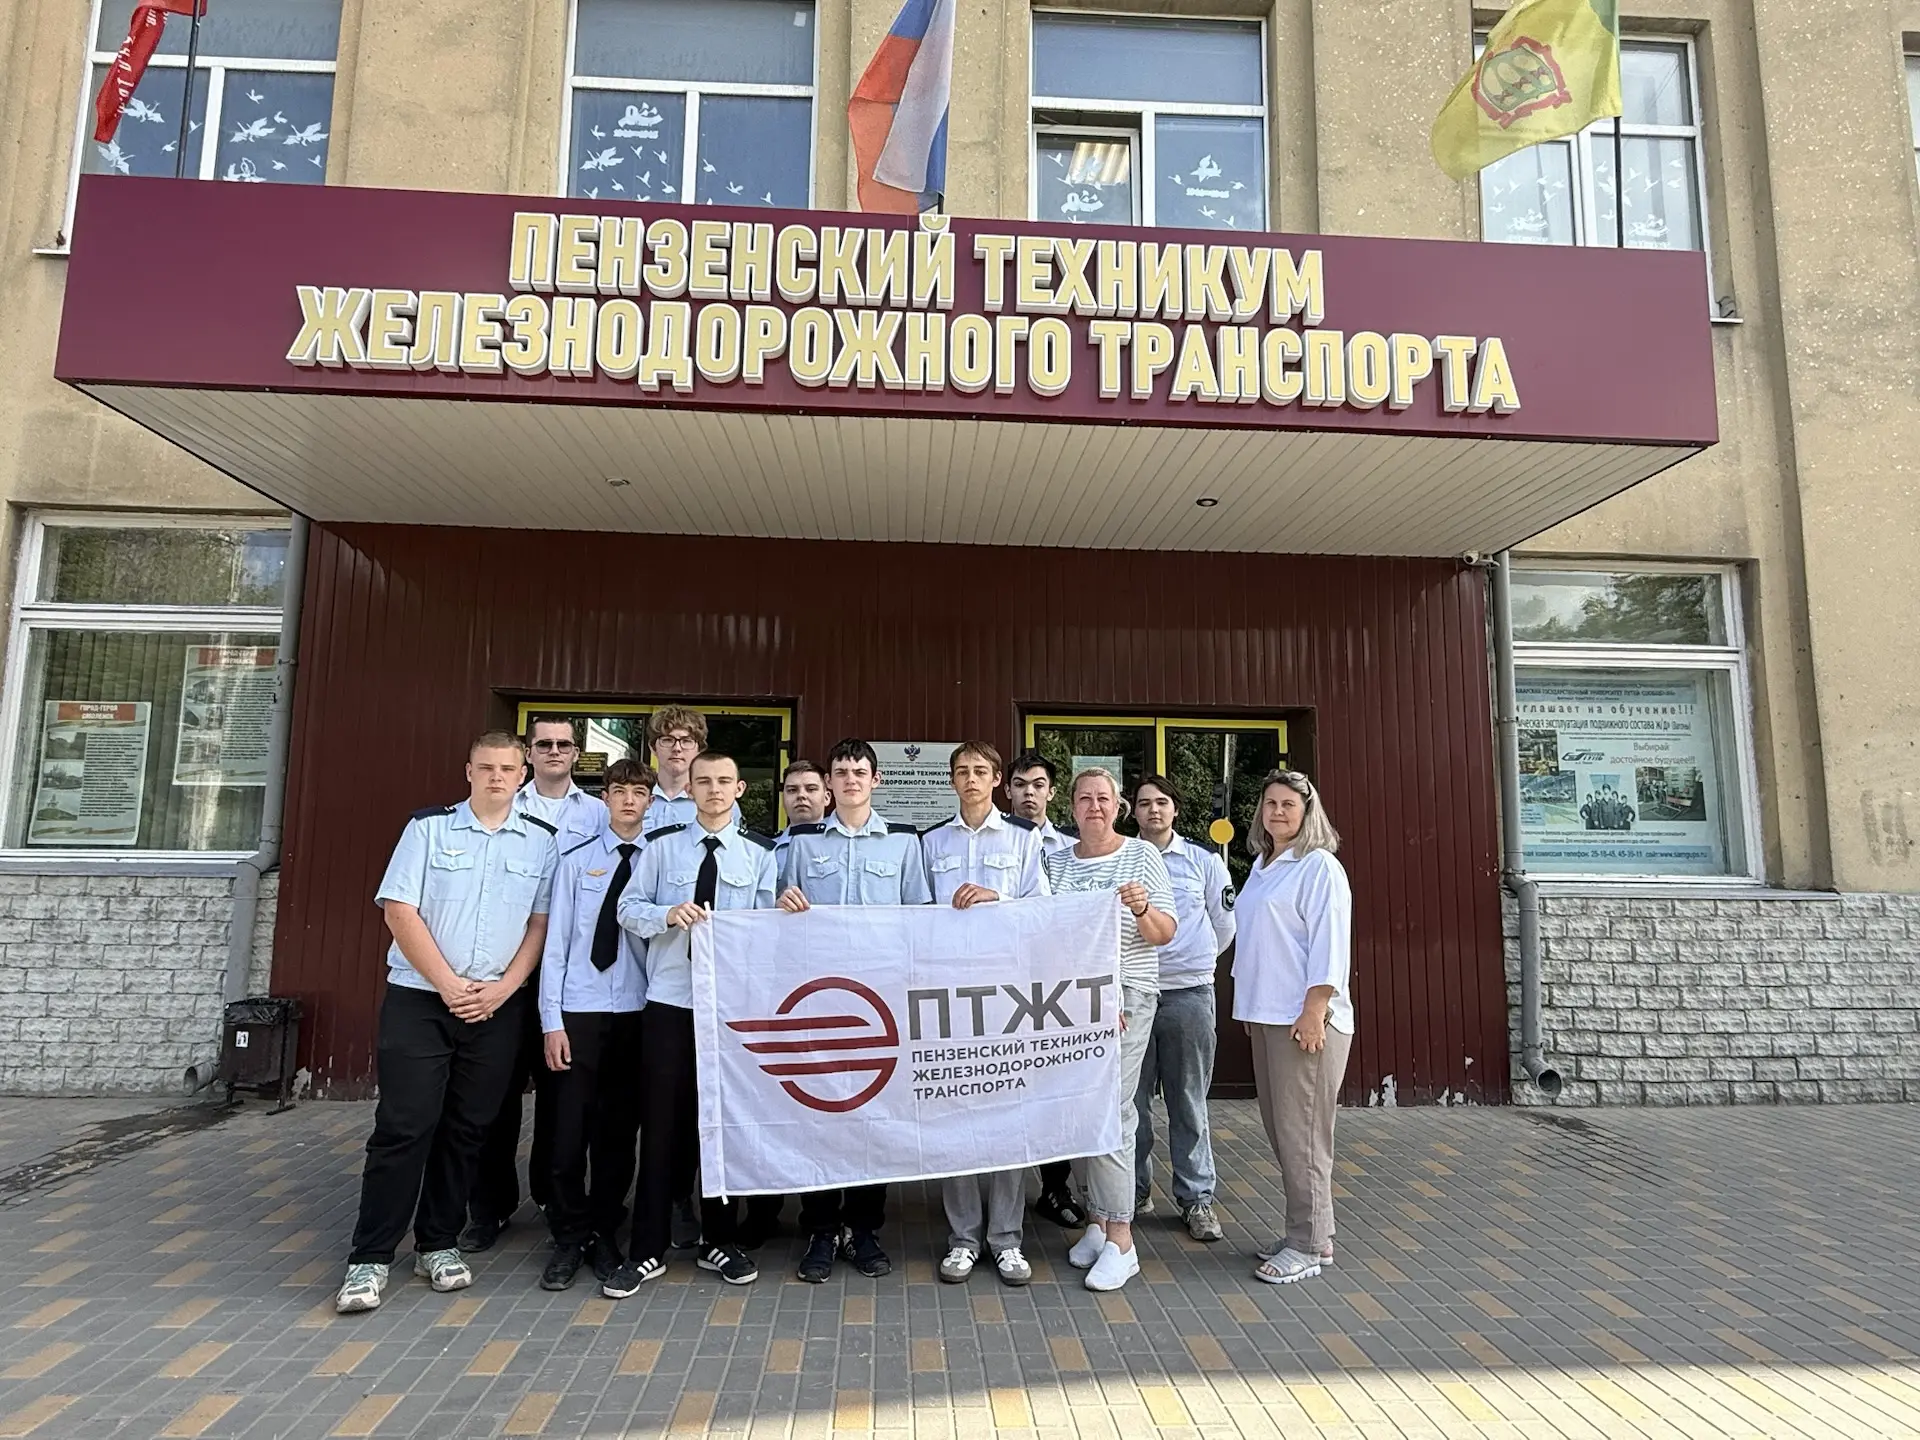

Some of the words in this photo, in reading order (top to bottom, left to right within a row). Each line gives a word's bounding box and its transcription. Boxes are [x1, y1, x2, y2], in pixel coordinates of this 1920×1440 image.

[509, 211, 955, 310] ПЕНЗЕНСКИЙ
[974, 233, 1325, 325] ТЕХНИКУМ
[286, 285, 1072, 396] ЖЕЛЕЗНОДОРОЖНОГО
[1088, 320, 1521, 415] ТРАНСПОРТА
[1588, 705, 1602, 714] на
[1633, 742, 1670, 752] Выбирай
[907, 975, 1114, 1040] ПТЖТ
[912, 1039, 1025, 1063] ПЕНЗЕНСКИЙ
[1030, 1028, 1115, 1052] ТЕХНИКУМ
[913, 1045, 1105, 1082] ЖЕЛЕЗНОДОРОЖНОГО
[913, 1077, 1026, 1100] ТРАНСПОРТА
